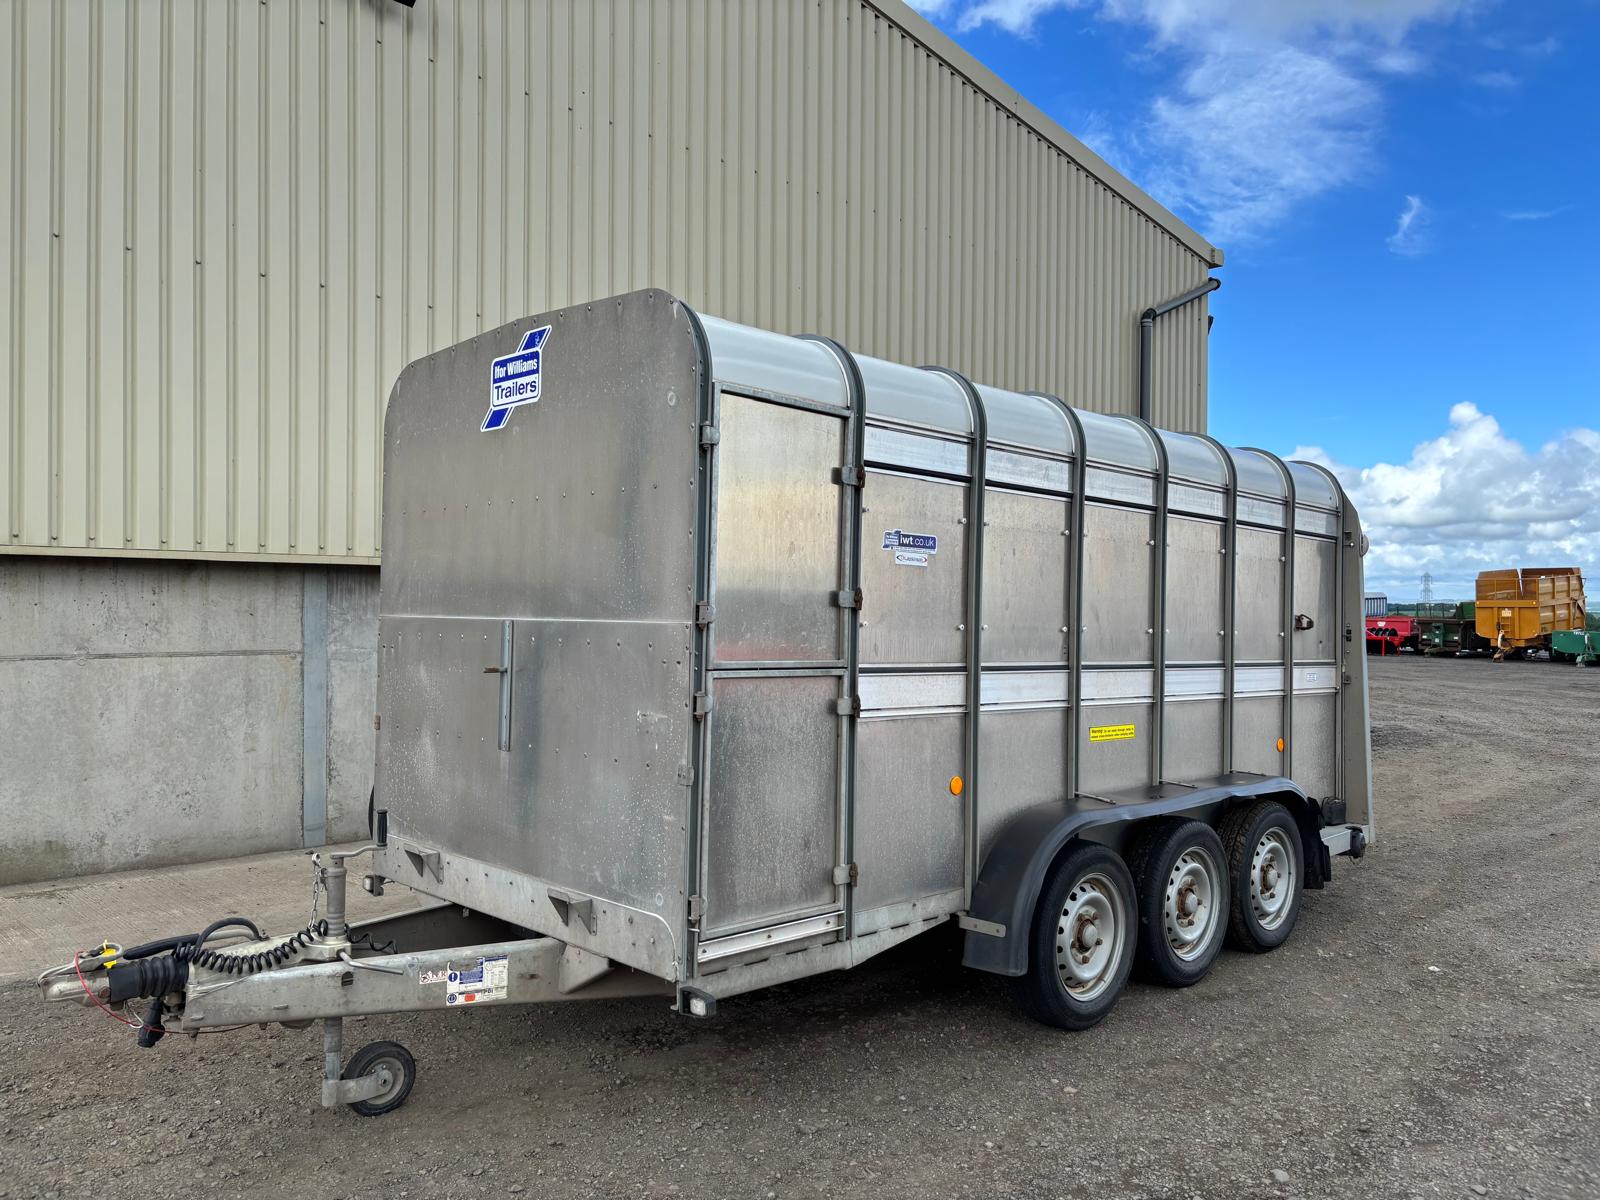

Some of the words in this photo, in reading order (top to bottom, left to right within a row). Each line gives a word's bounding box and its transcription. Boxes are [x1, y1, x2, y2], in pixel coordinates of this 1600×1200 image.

[494, 365, 507, 380] Ifor
[507, 359, 538, 376] Williams
[494, 380, 537, 401] Trailers
